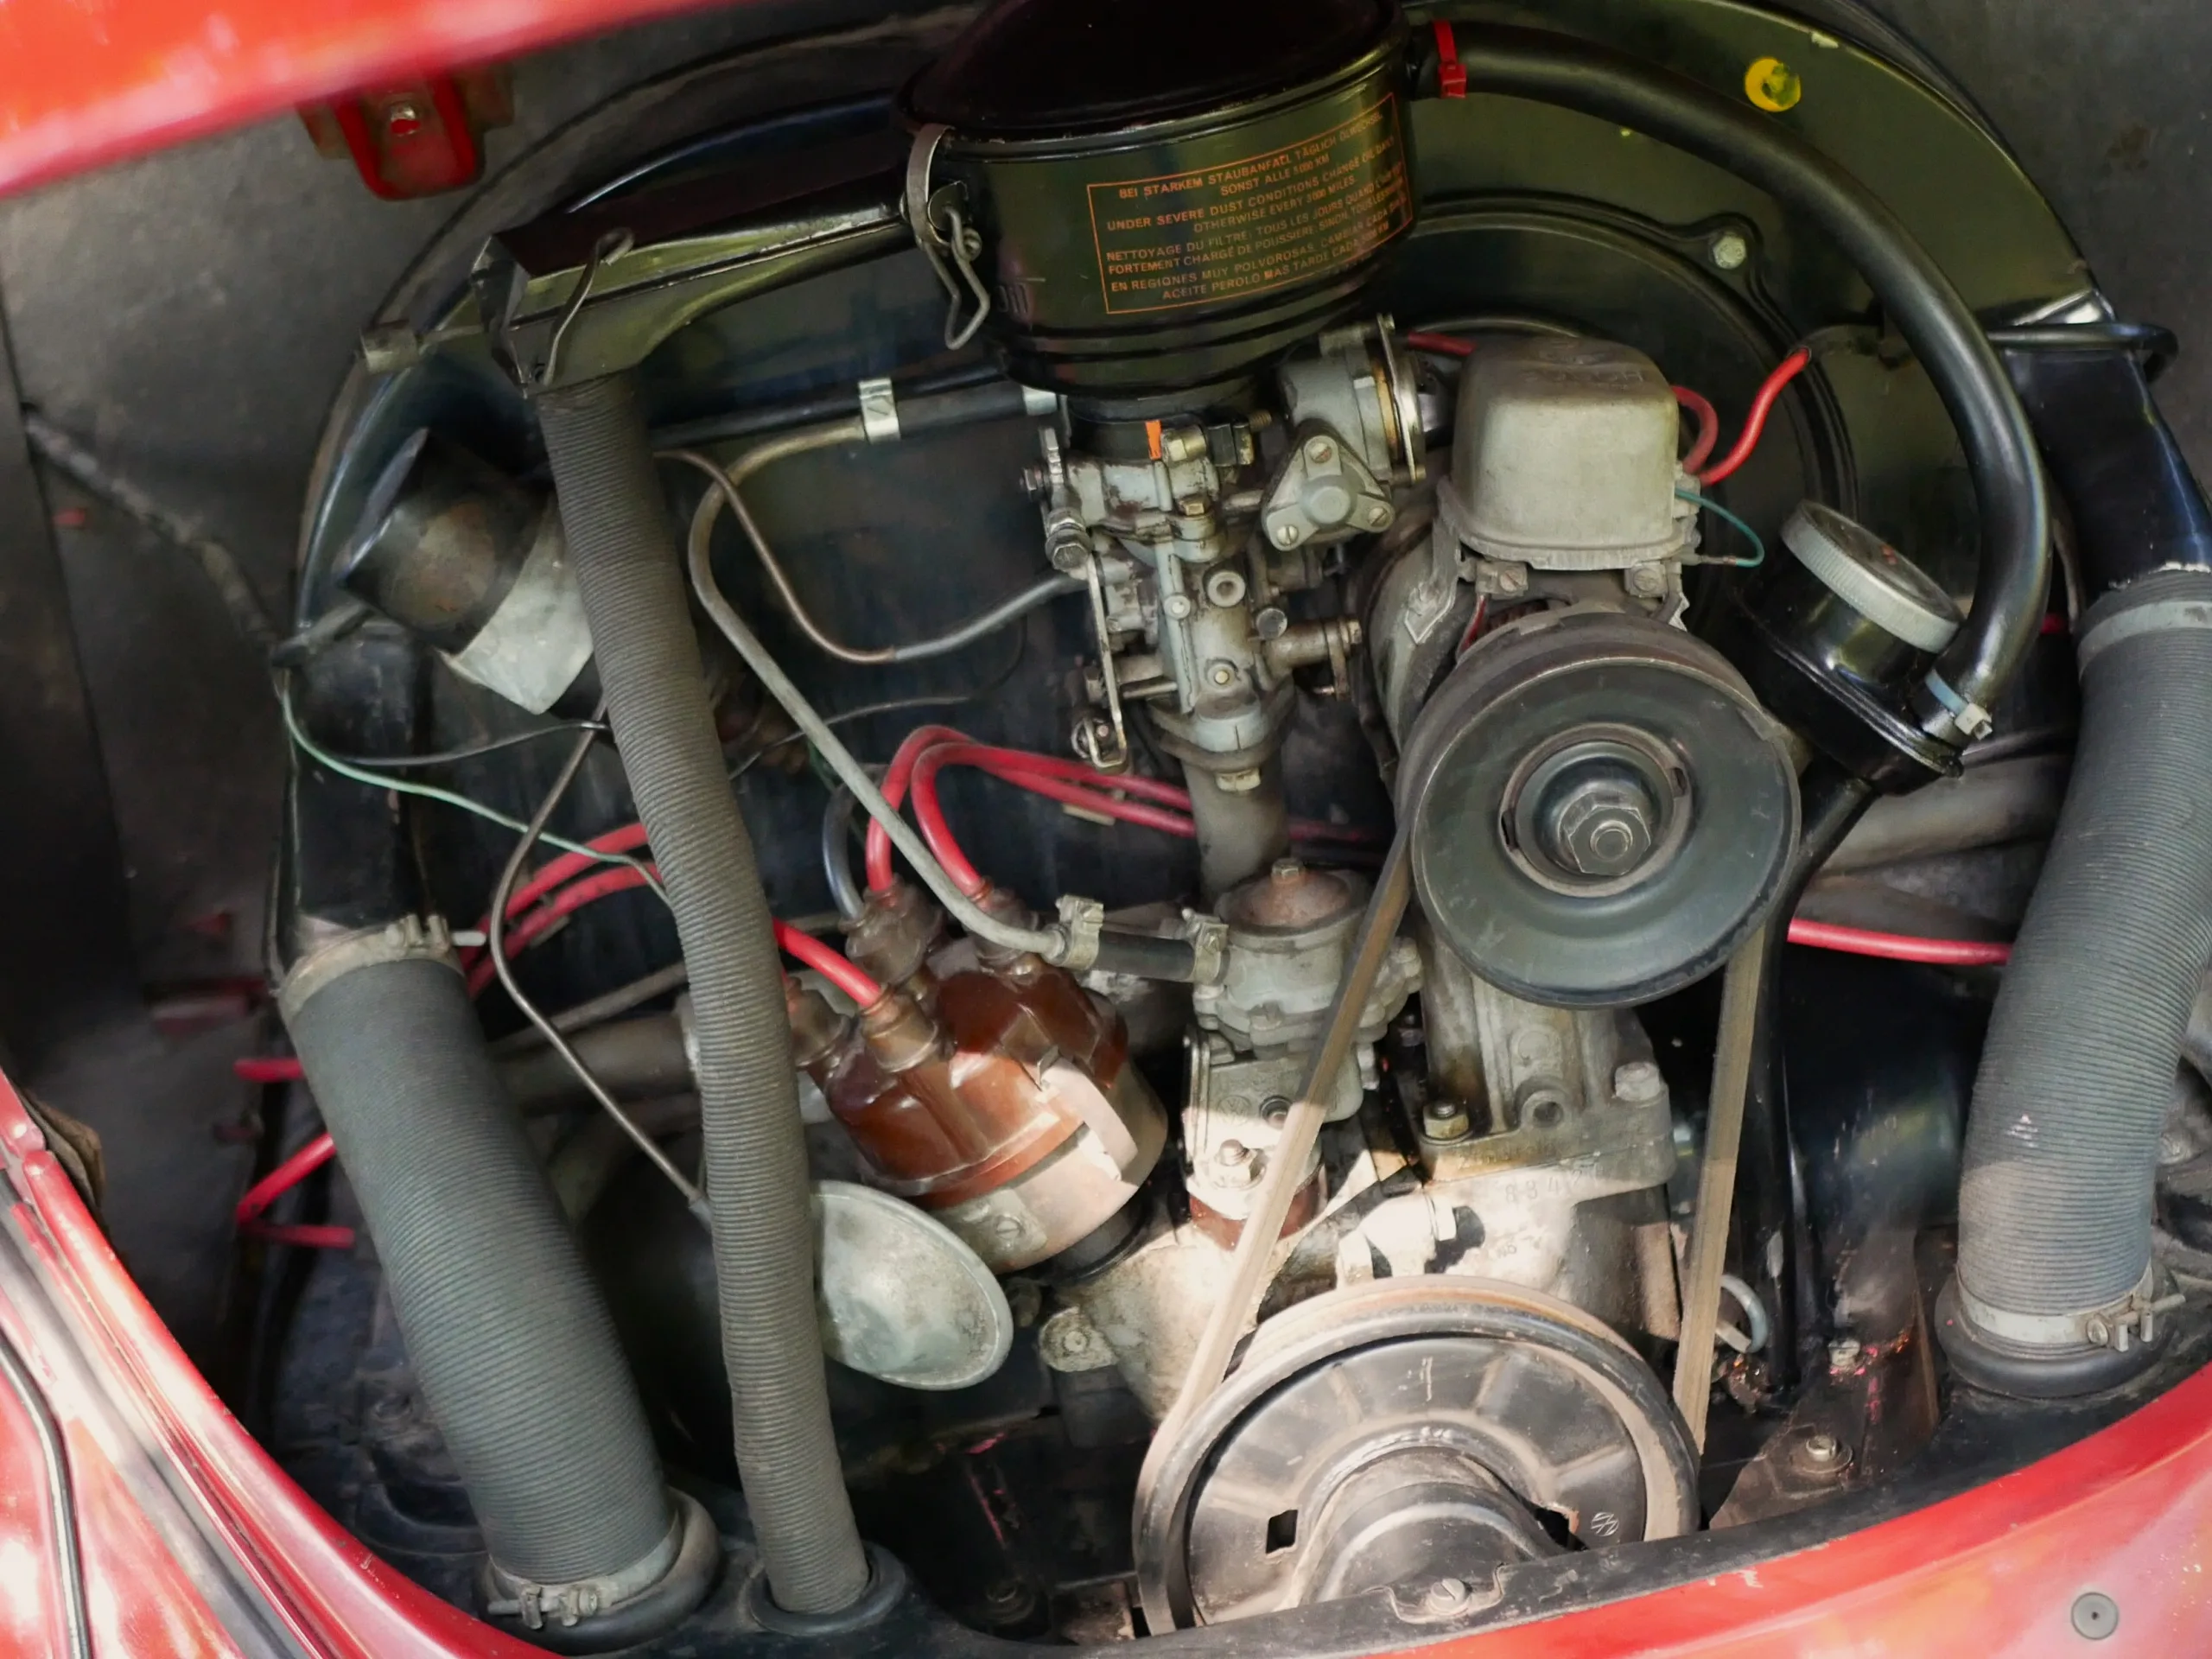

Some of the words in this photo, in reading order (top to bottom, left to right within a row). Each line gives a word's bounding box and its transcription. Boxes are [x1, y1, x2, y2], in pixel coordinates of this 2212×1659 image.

[1119, 188, 1138, 199] BEI
[1143, 178, 1204, 197] STARKEM
[1220, 178, 1259, 196] SONST
[1265, 168, 1290, 184] ALLE
[1315, 154, 1330, 167] KM
[1107, 218, 1152, 231] UNDER
[1157, 208, 1205, 226] SEVERE
[1210, 200, 1243, 216] DUST
[1249, 176, 1319, 207] CONDITIONS
[1322, 156, 1360, 181] CHANGE
[1106, 245, 1182, 261] NETTOYAGE
[1186, 241, 1204, 252] DU
[1256, 219, 1287, 235] TOUS
[1290, 213, 1309, 225] LES
[1313, 199, 1344, 220] JOURS
[1345, 182, 1374, 204] QUAND
[1194, 209, 1266, 232] OTHERWISE
[1269, 197, 1303, 215] EVERY
[1109, 257, 1179, 275] FORTEMENT
[1237, 245, 1253, 256] DE
[1111, 282, 1128, 292] EN
[1201, 266, 1229, 279] MUY
[1162, 283, 1207, 300] ACEITE
[1263, 264, 1291, 280] MAS
